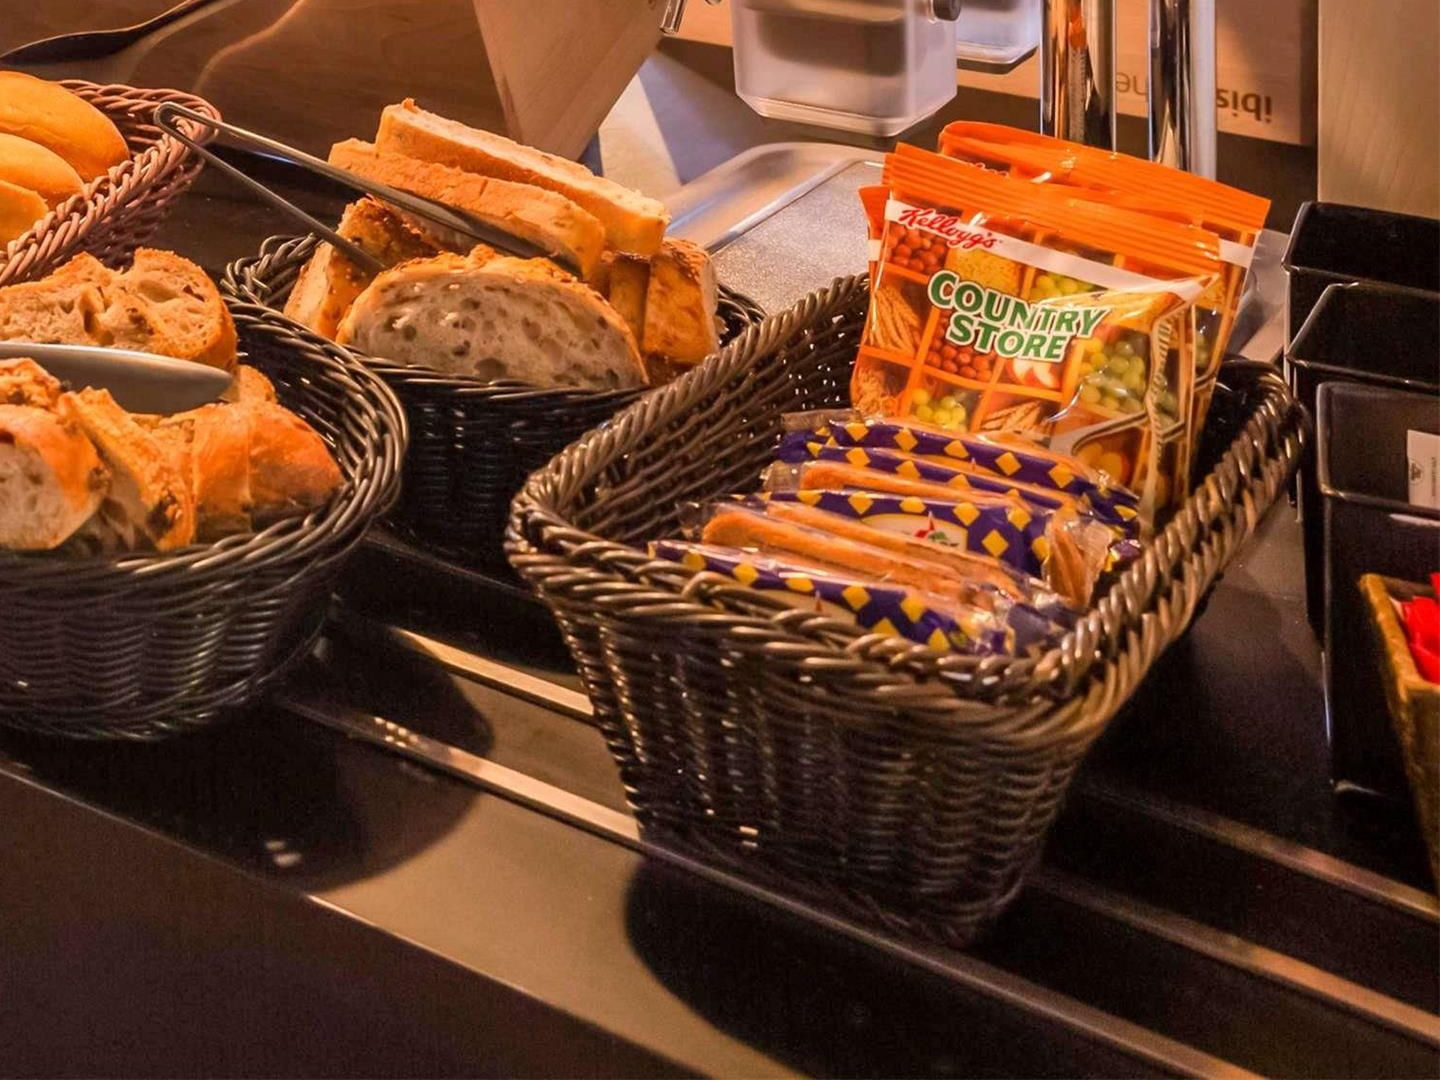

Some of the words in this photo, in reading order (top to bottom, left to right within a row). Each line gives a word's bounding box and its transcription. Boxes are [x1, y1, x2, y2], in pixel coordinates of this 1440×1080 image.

[1216, 88, 1273, 123] ibis
[899, 207, 998, 250] Kellogg's
[929, 272, 1107, 336] COUNTRY
[948, 314, 1068, 360] STORE
